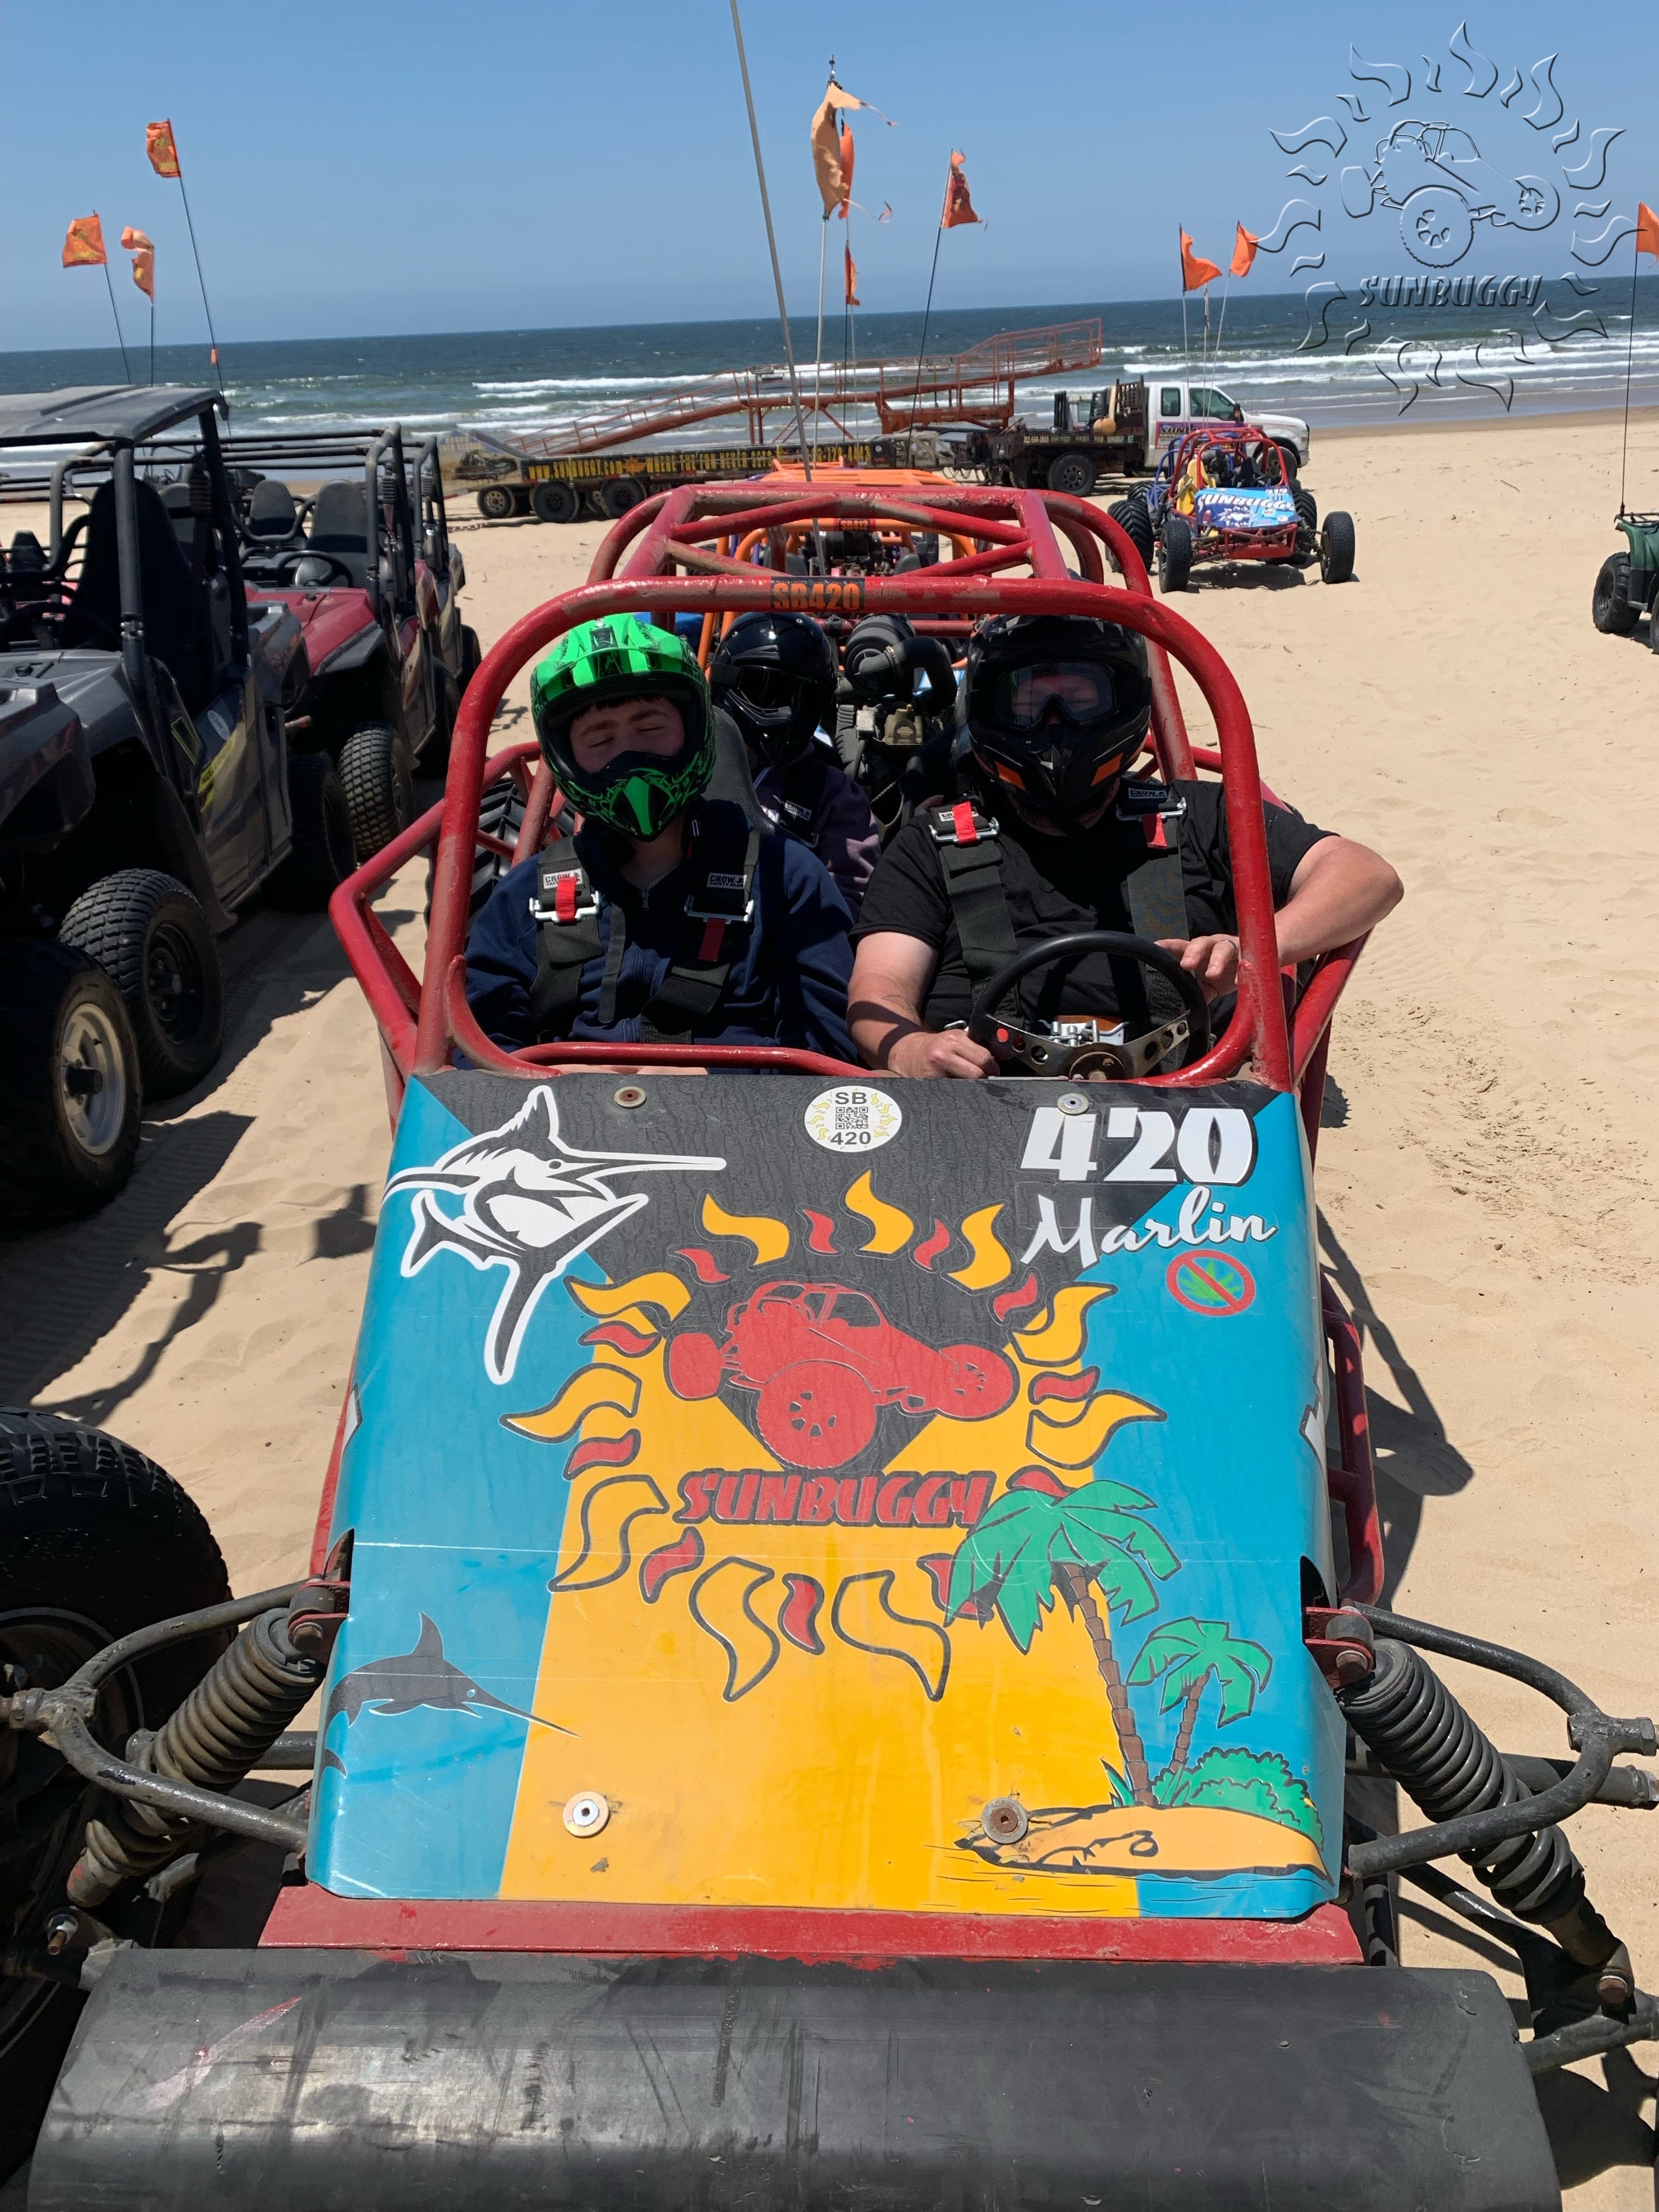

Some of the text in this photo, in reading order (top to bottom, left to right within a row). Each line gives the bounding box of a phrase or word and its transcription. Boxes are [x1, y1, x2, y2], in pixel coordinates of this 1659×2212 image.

[645, 454, 676, 473] WHERE
[679, 453, 696, 470] THE
[700, 452, 715, 470] FUN
[720, 450, 747, 470] NEVER
[1198, 494, 1295, 512] SUNBUGGY
[772, 582, 860, 610] SB420
[710, 875, 735, 883] CROW
[834, 1092, 867, 1105] SB
[830, 1131, 871, 1146] 420
[1020, 1107, 1255, 1184] 420
[1019, 1185, 1278, 1268] Marlin
[677, 1472, 991, 1525] SUNBUGGY
